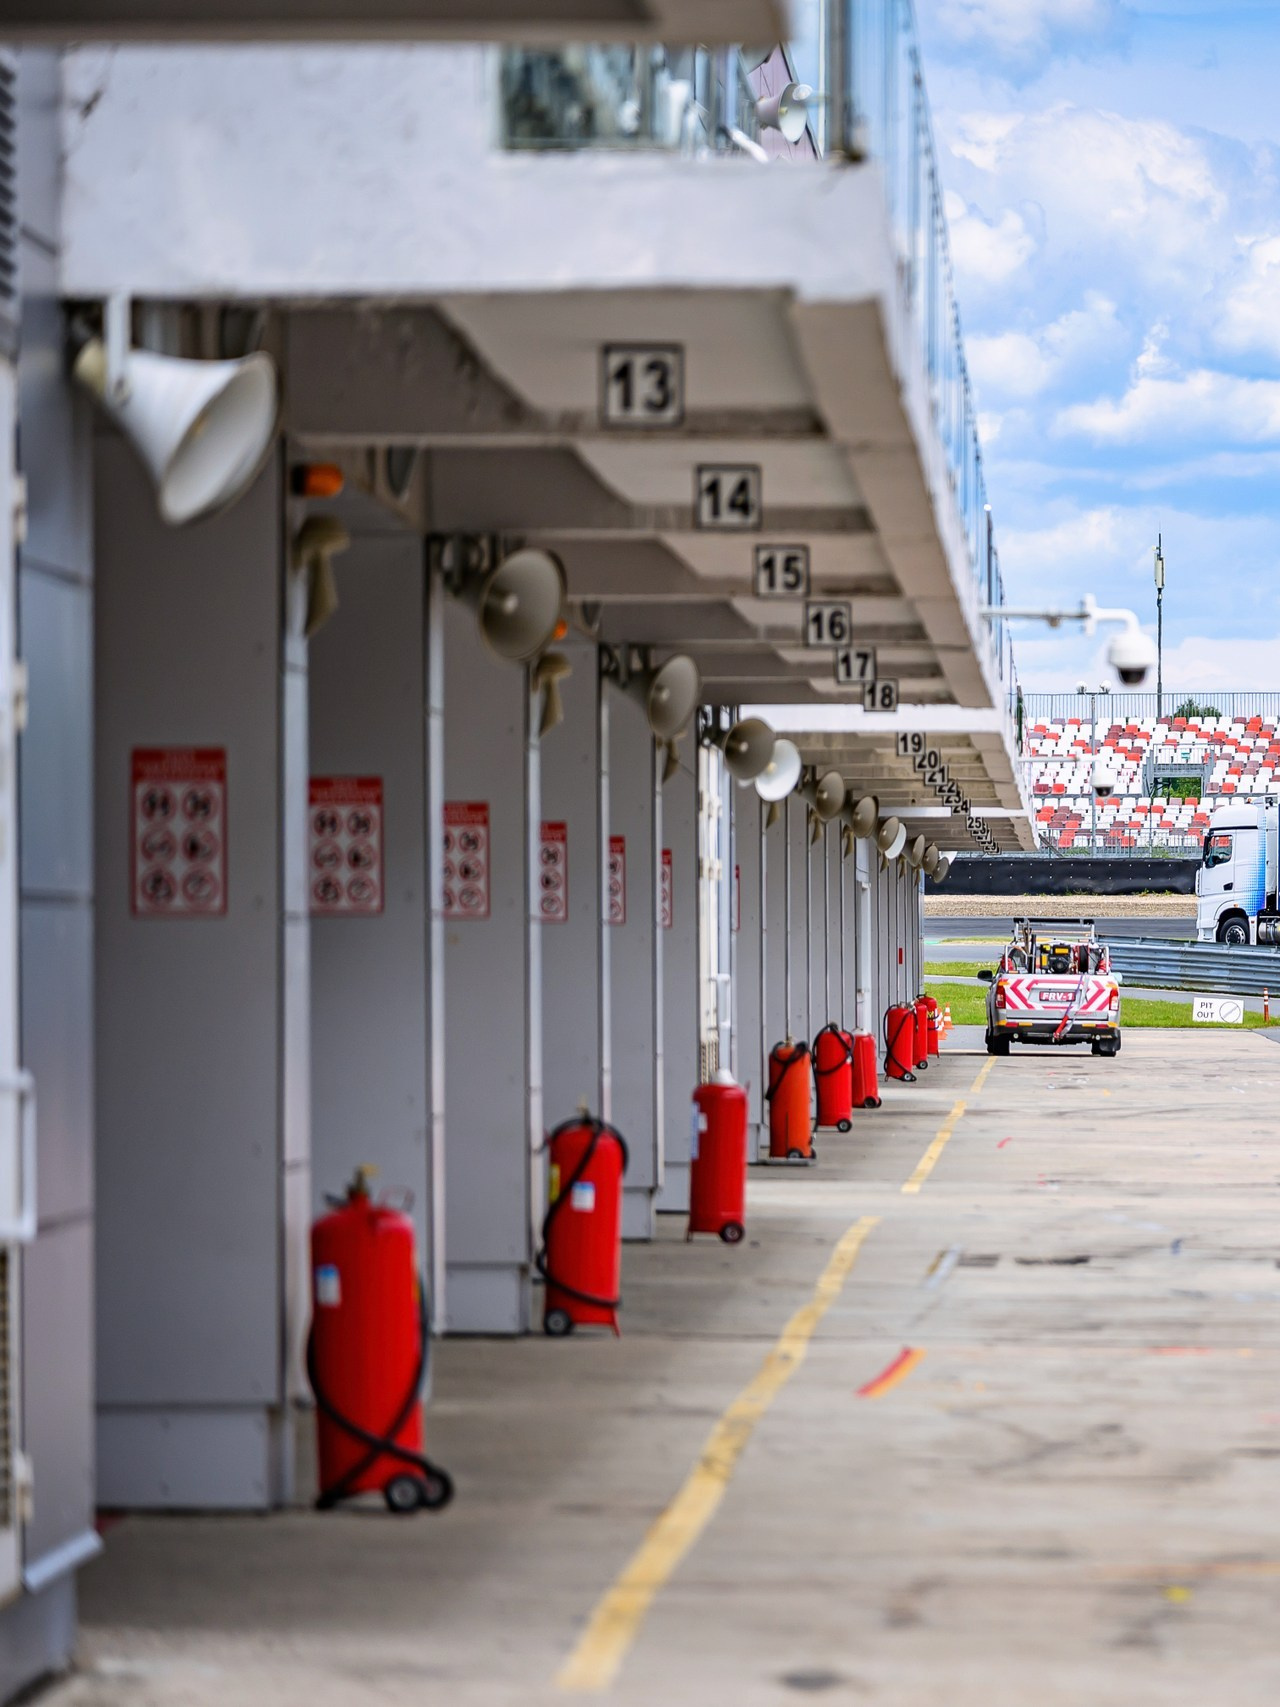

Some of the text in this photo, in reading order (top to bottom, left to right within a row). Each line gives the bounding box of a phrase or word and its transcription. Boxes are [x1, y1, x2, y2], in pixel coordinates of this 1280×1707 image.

[613, 359, 674, 413] 13
[704, 477, 753, 519] 14
[761, 555, 802, 591] 15
[810, 610, 847, 641] 16
[840, 652, 869, 679] 17
[867, 684, 894, 709] 18
[900, 733, 922, 753] 19
[917, 751, 938, 769] 20
[928, 766, 946, 783] 21
[967, 817, 982, 829] 25
[1042, 992, 1073, 1001] FRV-1
[1200, 1001, 1213, 1009] PIT
[1197, 1011, 1214, 1019] OUT
